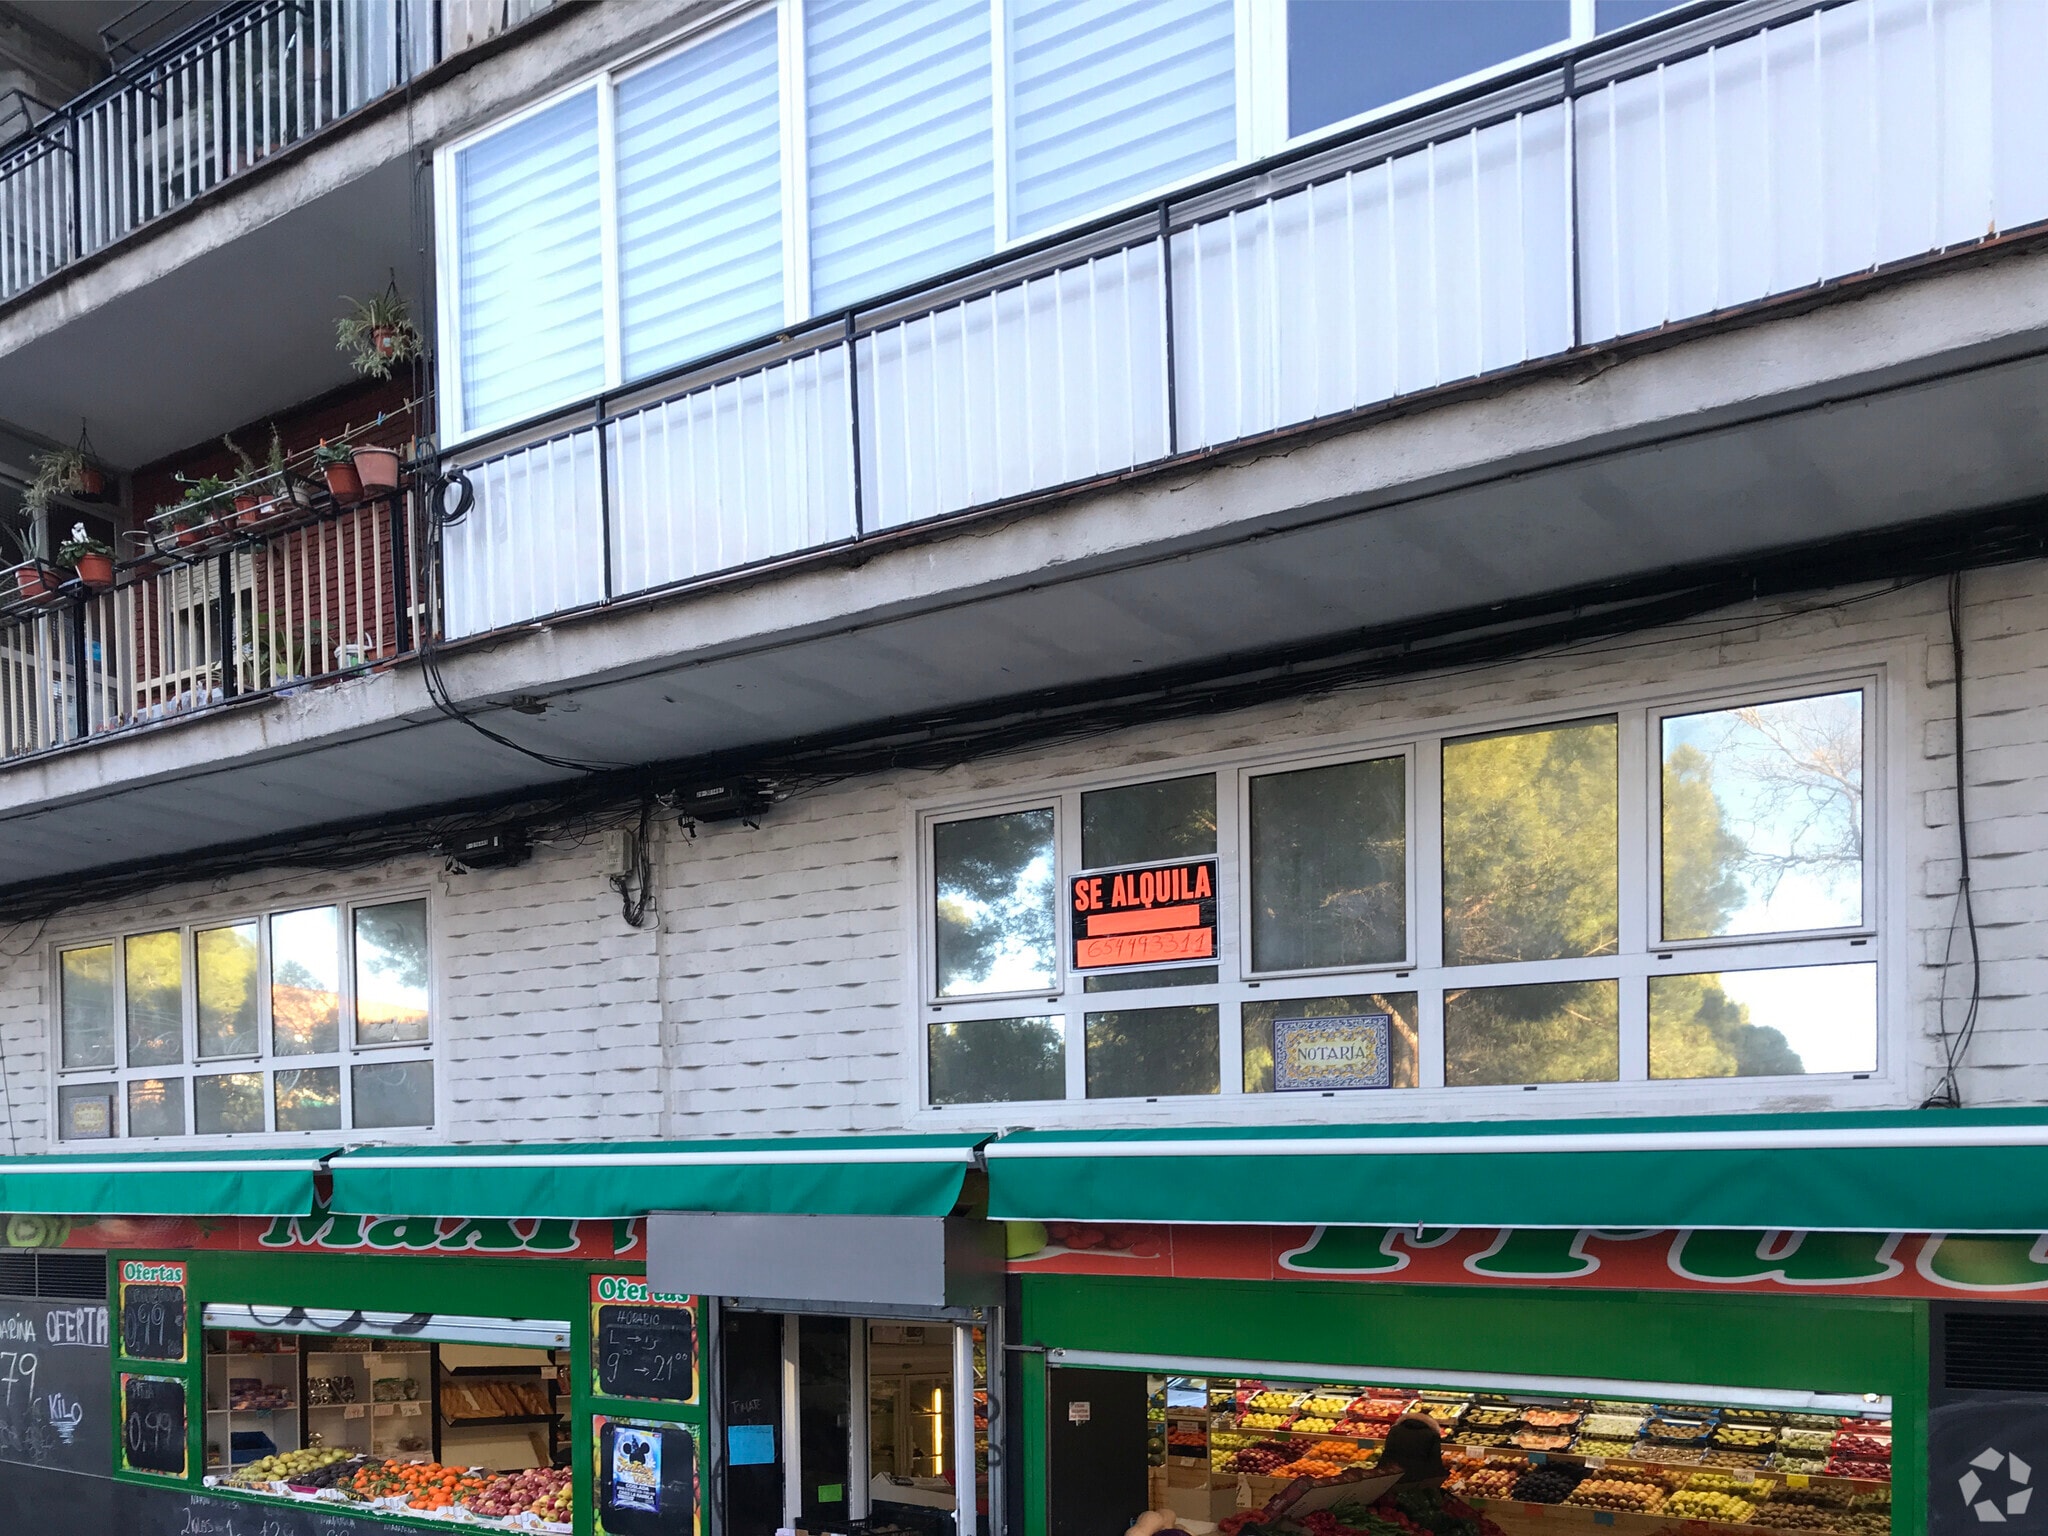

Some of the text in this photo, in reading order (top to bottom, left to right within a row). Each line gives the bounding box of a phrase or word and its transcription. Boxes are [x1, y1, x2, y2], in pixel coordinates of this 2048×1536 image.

[1075, 865, 1212, 912] SE ALQUILA
[1297, 1043, 1366, 1061] NOTARÍA
[124, 1262, 183, 1283] Ofertas
[46, 1306, 109, 1345] OFERTA
